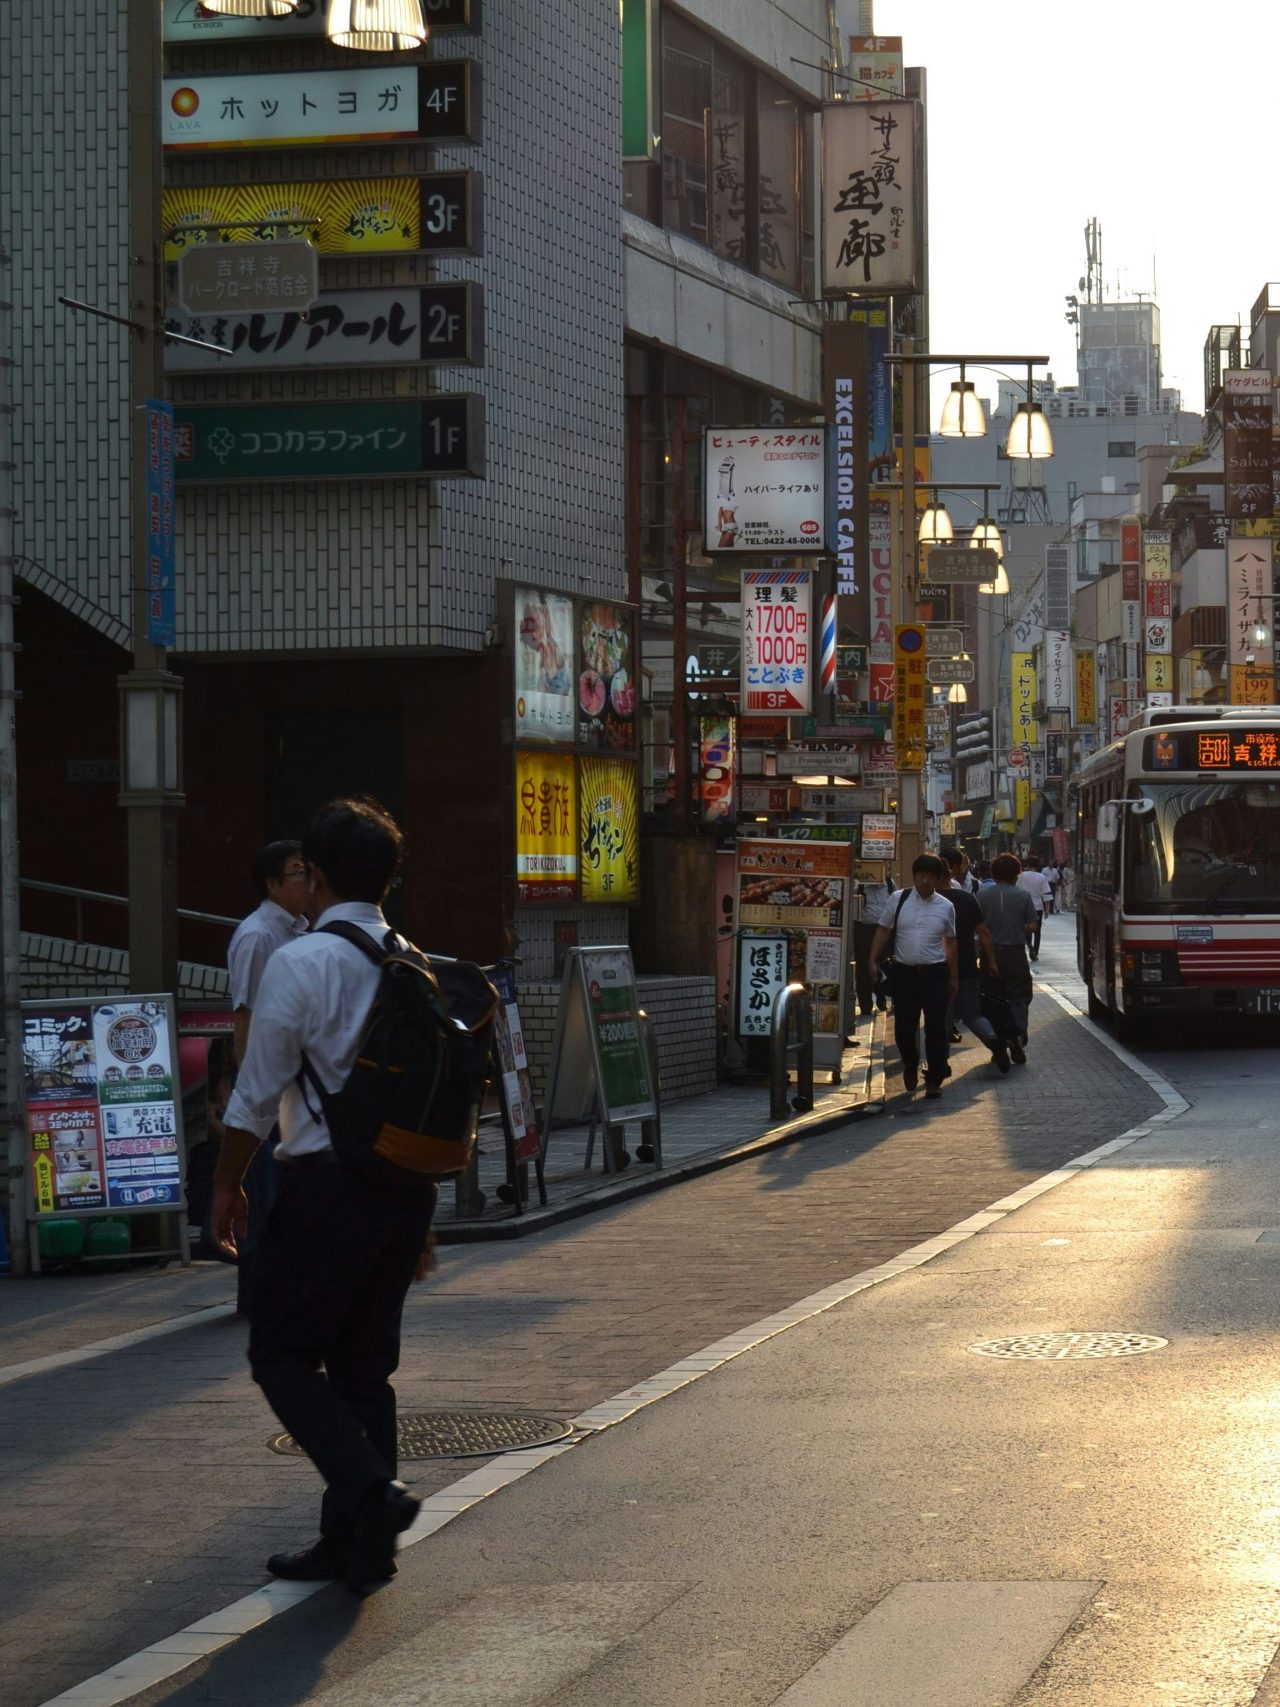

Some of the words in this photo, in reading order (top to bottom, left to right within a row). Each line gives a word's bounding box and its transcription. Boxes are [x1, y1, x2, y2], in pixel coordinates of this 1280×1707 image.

[864, 39, 887, 51] 4F
[859, 66, 895, 81] 猫カフェ
[220, 85, 402, 121] ホットヨガ
[426, 87, 457, 114] 4F
[169, 121, 201, 131] LAVA
[427, 194, 460, 234] 3F
[833, 170, 886, 282] 画廊
[216, 256, 281, 278] 吉祥寺
[428, 304, 460, 343] 2F
[1226, 377, 1270, 387] イケダビル
[876, 388, 886, 426] tanning
[240, 427, 407, 454] ココカラファイン
[430, 417, 460, 454] 1F
[712, 434, 821, 448] ビューティスタイル
[834, 378, 854, 510] EXCELSIOR
[1229, 452, 1269, 467] Salva
[1241, 504, 1257, 512] 2F
[836, 519, 859, 596] CAFFÉ
[755, 586, 798, 603] 理髪
[1237, 568, 1252, 651] ミライザカ
[756, 605, 807, 633] 1700円
[756, 636, 807, 664] 1000円
[836, 649, 860, 666] 内
[747, 667, 804, 684] ことぶき
[1079, 660, 1092, 717] FOREST
[767, 693, 787, 707] 3F
[1236, 692, 1268, 703] 生ビール
[530, 709, 572, 726] ホットヨガ
[778, 828, 810, 839] レイク
[526, 856, 563, 871] TORIKIZOKU
[518, 884, 528, 898] 7F
[602, 874, 614, 891] 3F
[25, 1034, 61, 1052] 雑誌
[124, 1048, 142, 1060] OK
[133, 1108, 174, 1117] 携帯スマホ
[48, 1120, 96, 1129] コミックカフェ
[137, 1116, 172, 1134] 充電
[34, 1133, 49, 1142] 24
[106, 1137, 176, 1156] 充電器無料
